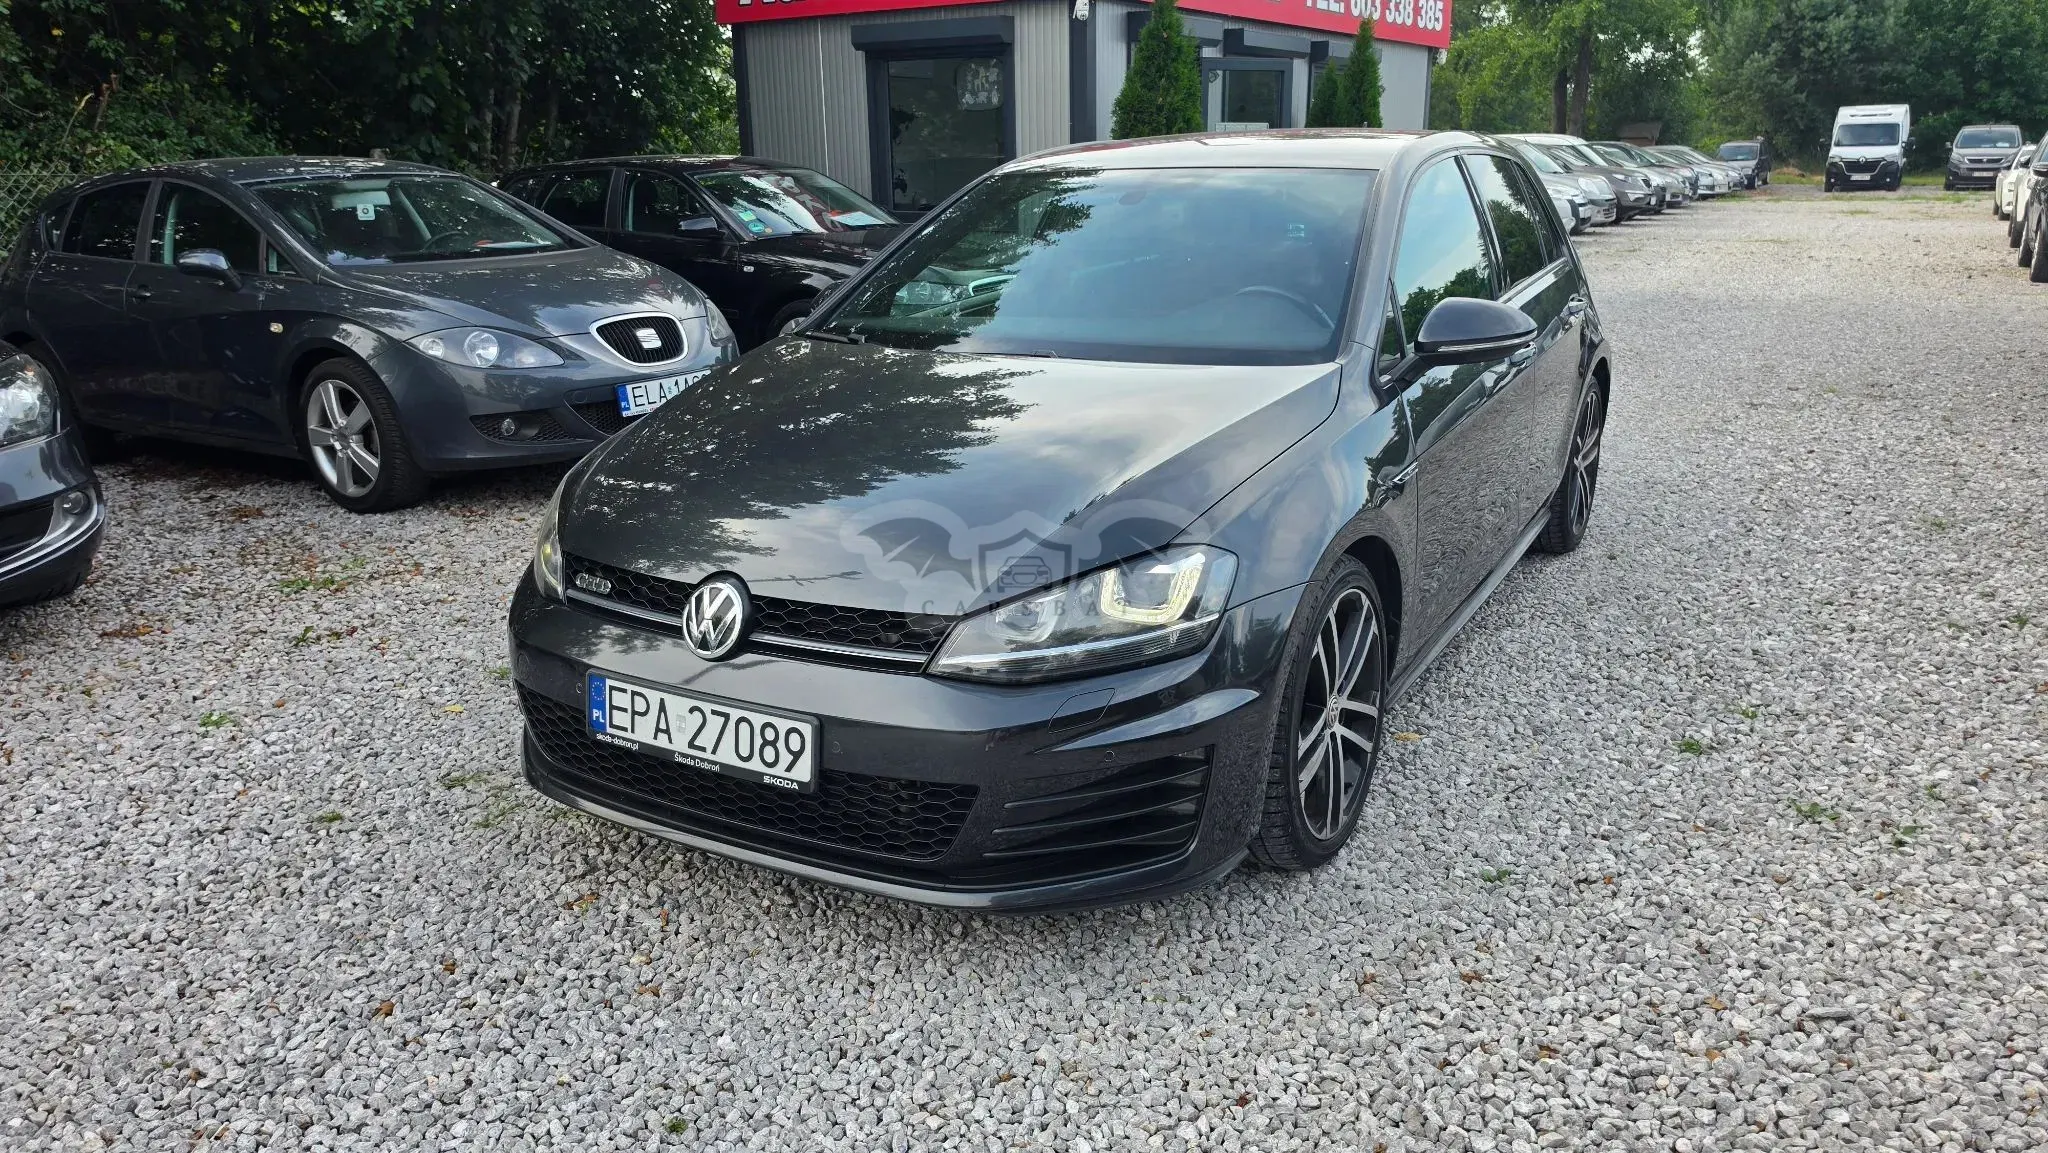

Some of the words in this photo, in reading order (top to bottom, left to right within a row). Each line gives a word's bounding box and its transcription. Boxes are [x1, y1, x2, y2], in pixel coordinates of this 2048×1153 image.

[1386, 0, 1414, 26] 338
[1418, 0, 1443, 31] 385
[631, 382, 668, 407] ELA
[592, 708, 605, 723] PL
[608, 684, 673, 745] EPA
[687, 705, 806, 773] 27089
